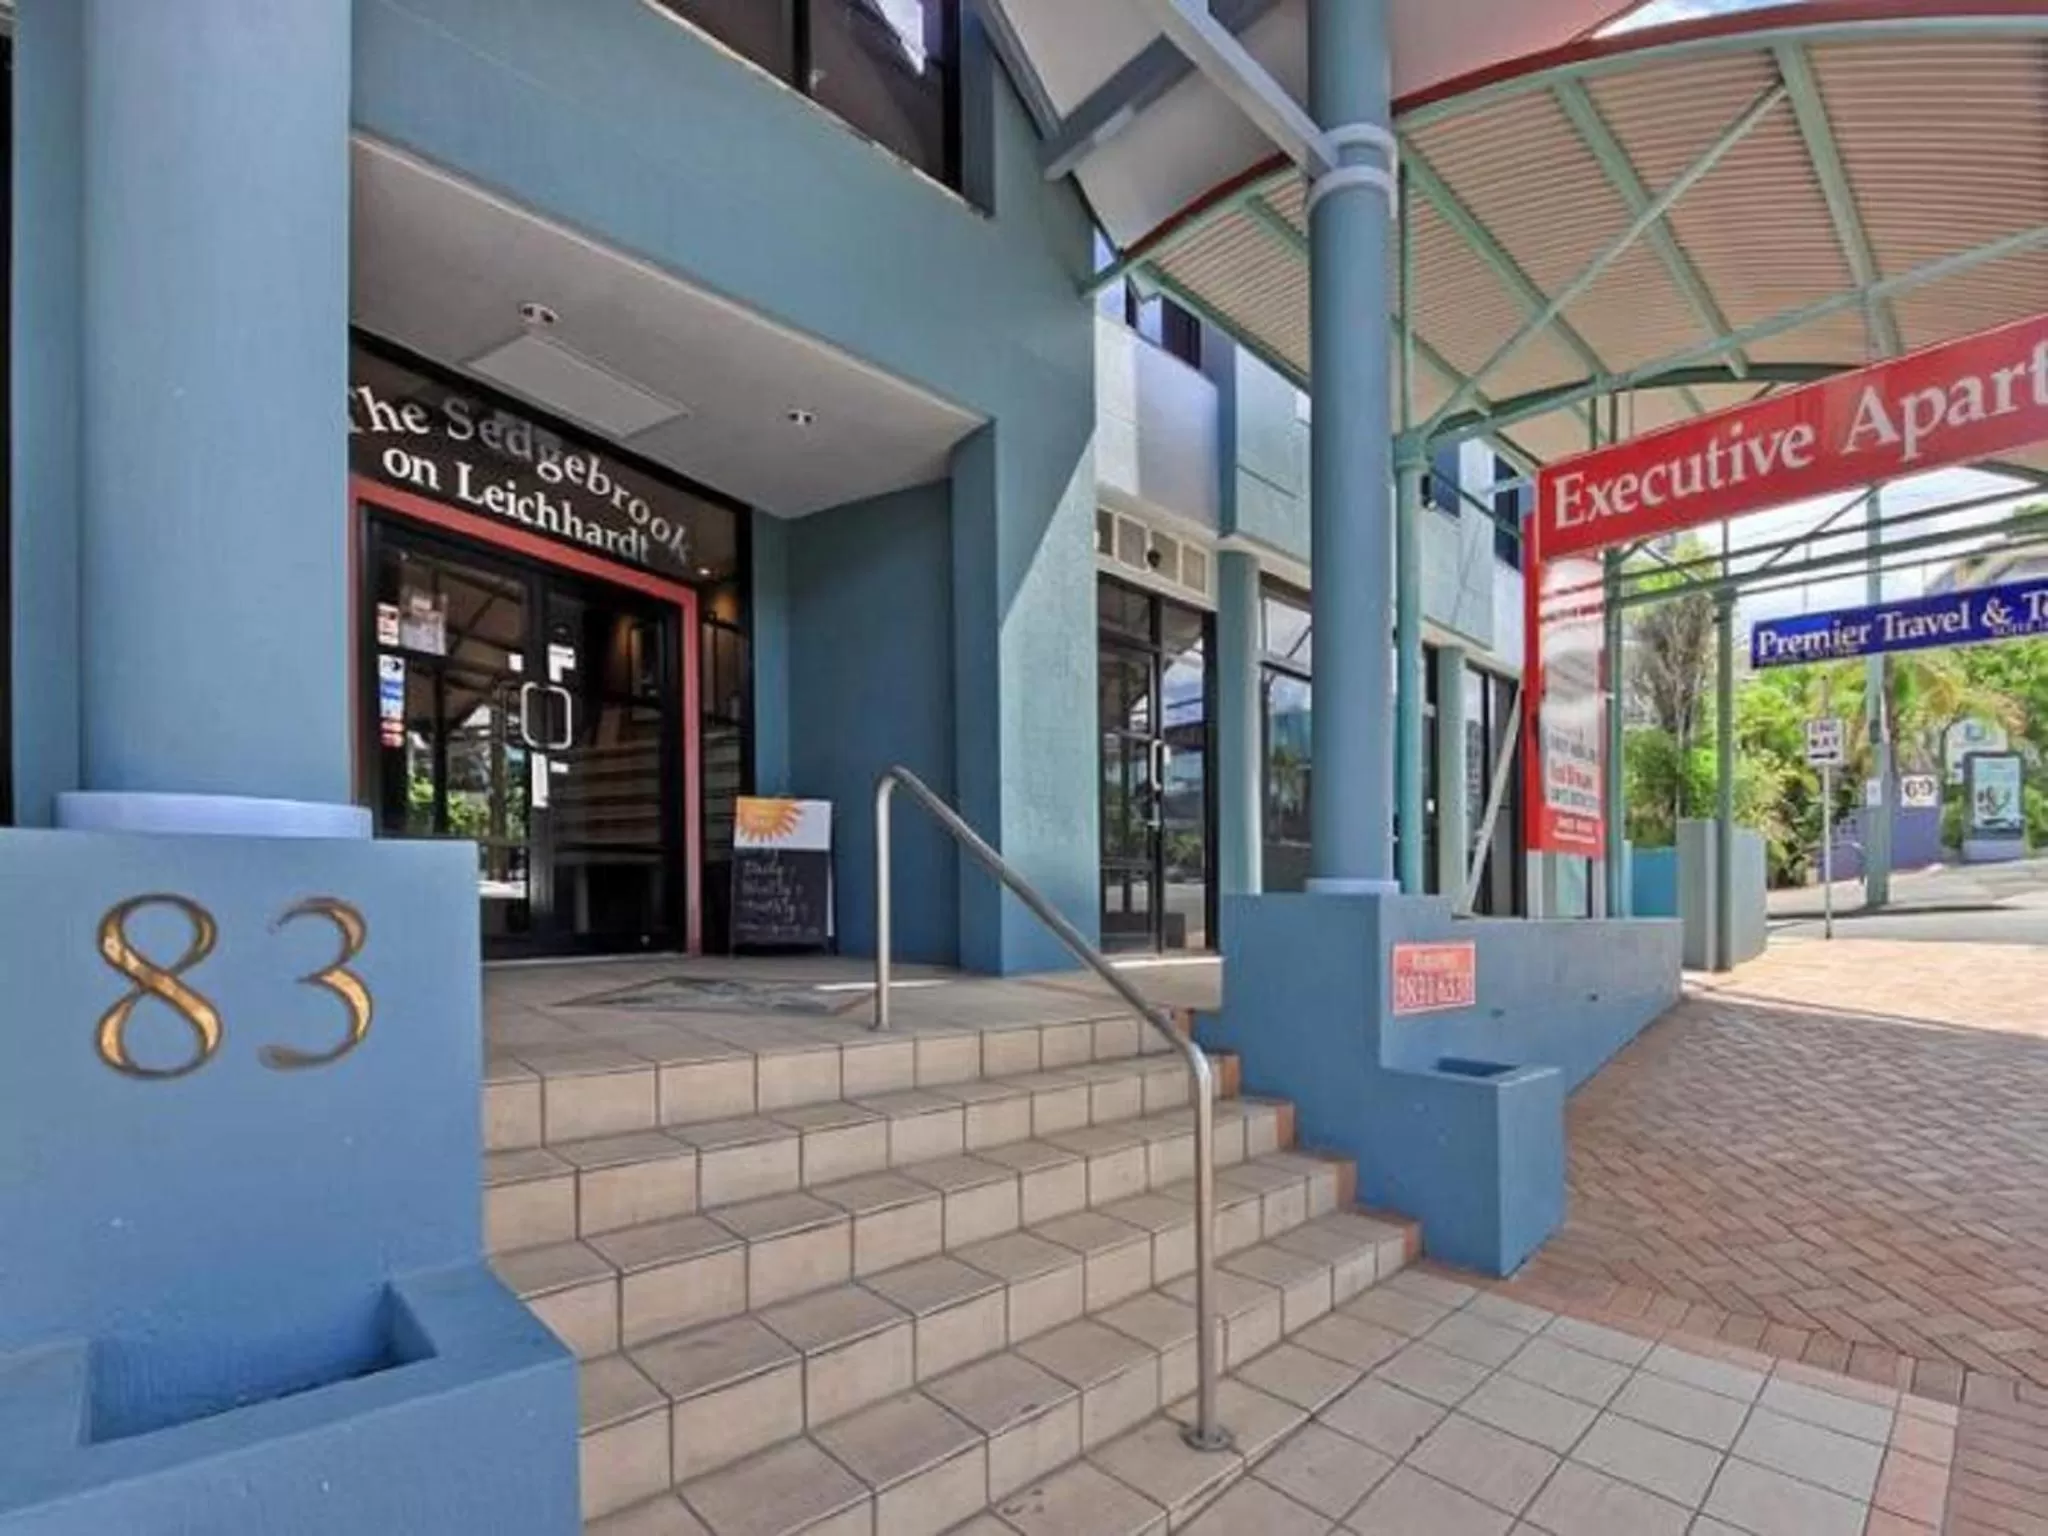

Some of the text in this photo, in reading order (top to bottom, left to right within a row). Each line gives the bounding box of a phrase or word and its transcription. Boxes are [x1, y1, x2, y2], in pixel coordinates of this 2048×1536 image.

[382, 447, 650, 564] on Leichhardt
[443, 396, 692, 565] Sedgebrook
[1552, 421, 1817, 530] Executive
[1757, 619, 1872, 657] Premier
[1876, 600, 1970, 643] Travel
[1981, 596, 2015, 628] &
[93, 892, 374, 1081] 83
